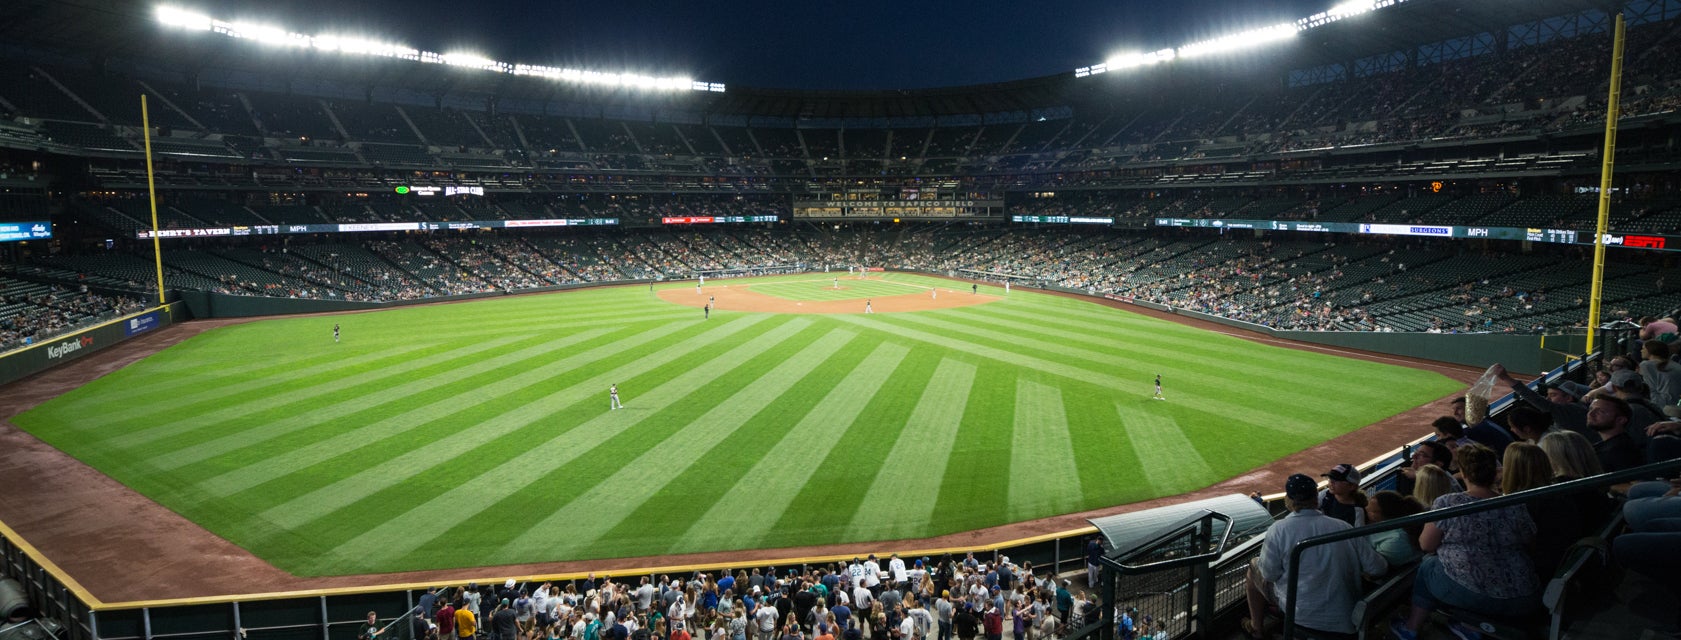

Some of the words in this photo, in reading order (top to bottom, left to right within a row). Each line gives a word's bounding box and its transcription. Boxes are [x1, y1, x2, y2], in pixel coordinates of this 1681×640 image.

[148, 229, 191, 237] HENRY'S
[194, 228, 231, 236] TAVERN
[1467, 228, 1488, 237] MPH
[1623, 235, 1666, 249] ESPN
[47, 338, 82, 359] KeyBank
[852, 568, 862, 577] 22
